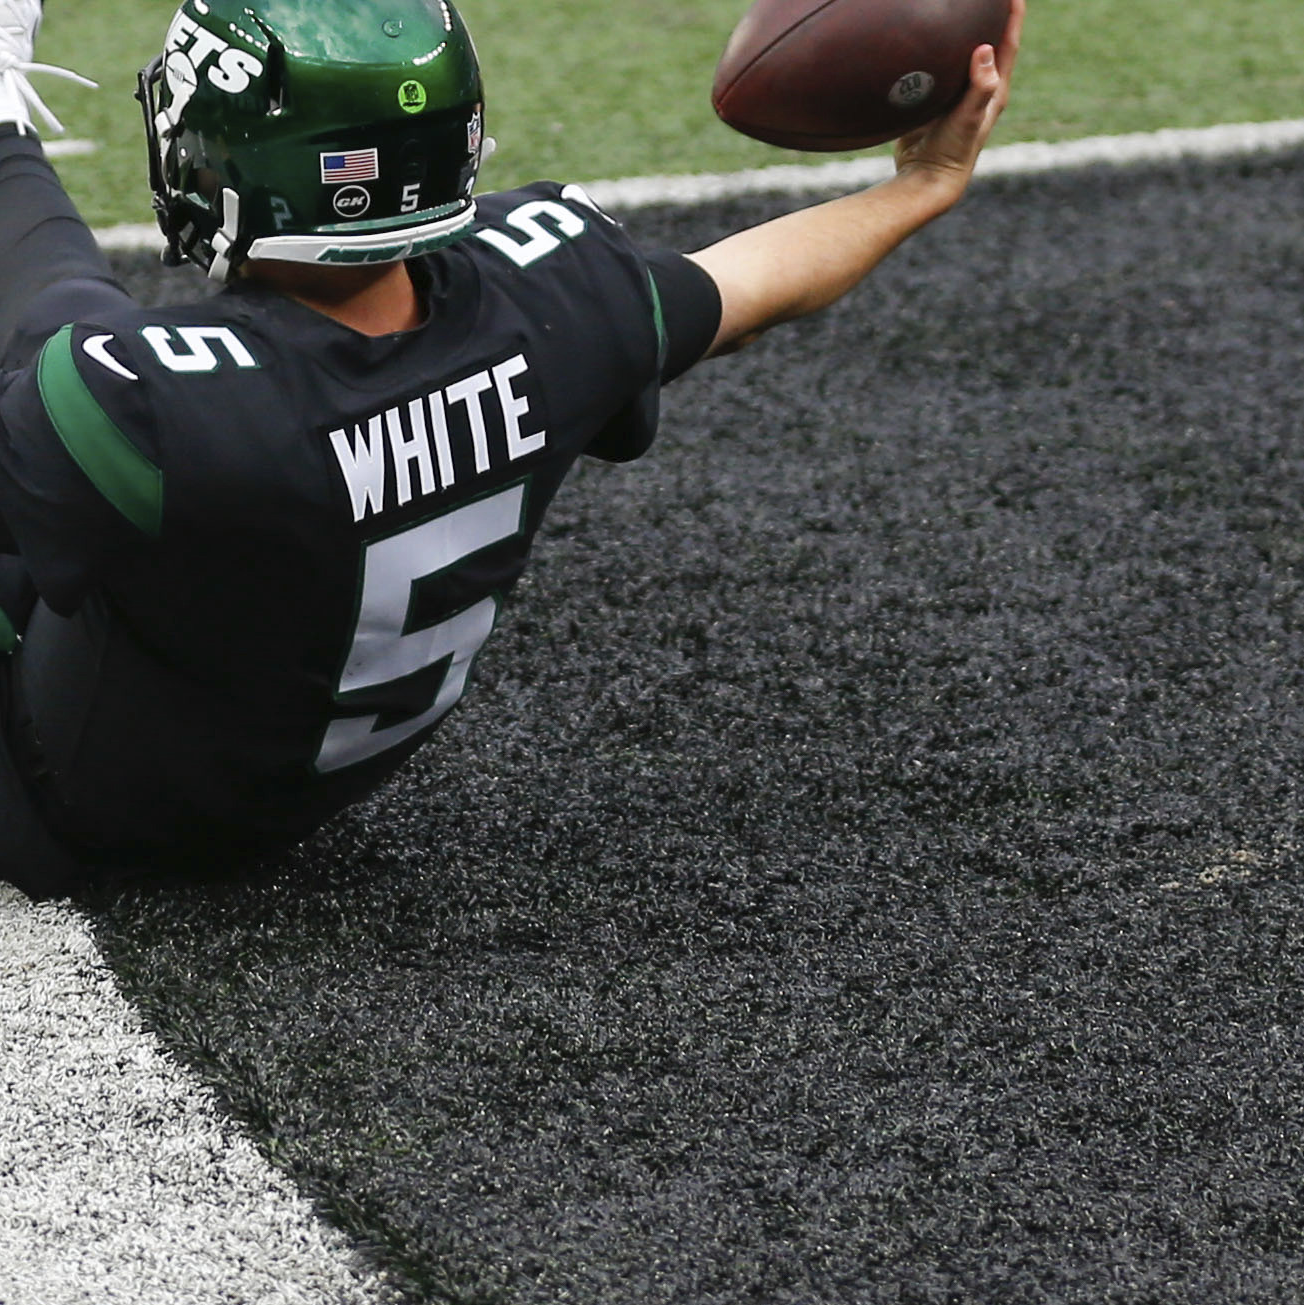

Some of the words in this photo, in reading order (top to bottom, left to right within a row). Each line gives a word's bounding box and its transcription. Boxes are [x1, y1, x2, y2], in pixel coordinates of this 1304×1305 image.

[165, 7, 264, 94] ETS
[336, 196, 366, 207] GK
[400, 182, 421, 212] 5
[473, 200, 587, 268] 5
[139, 325, 260, 373] 5
[329, 353, 546, 522] WHITE
[313, 474, 531, 775] 5
